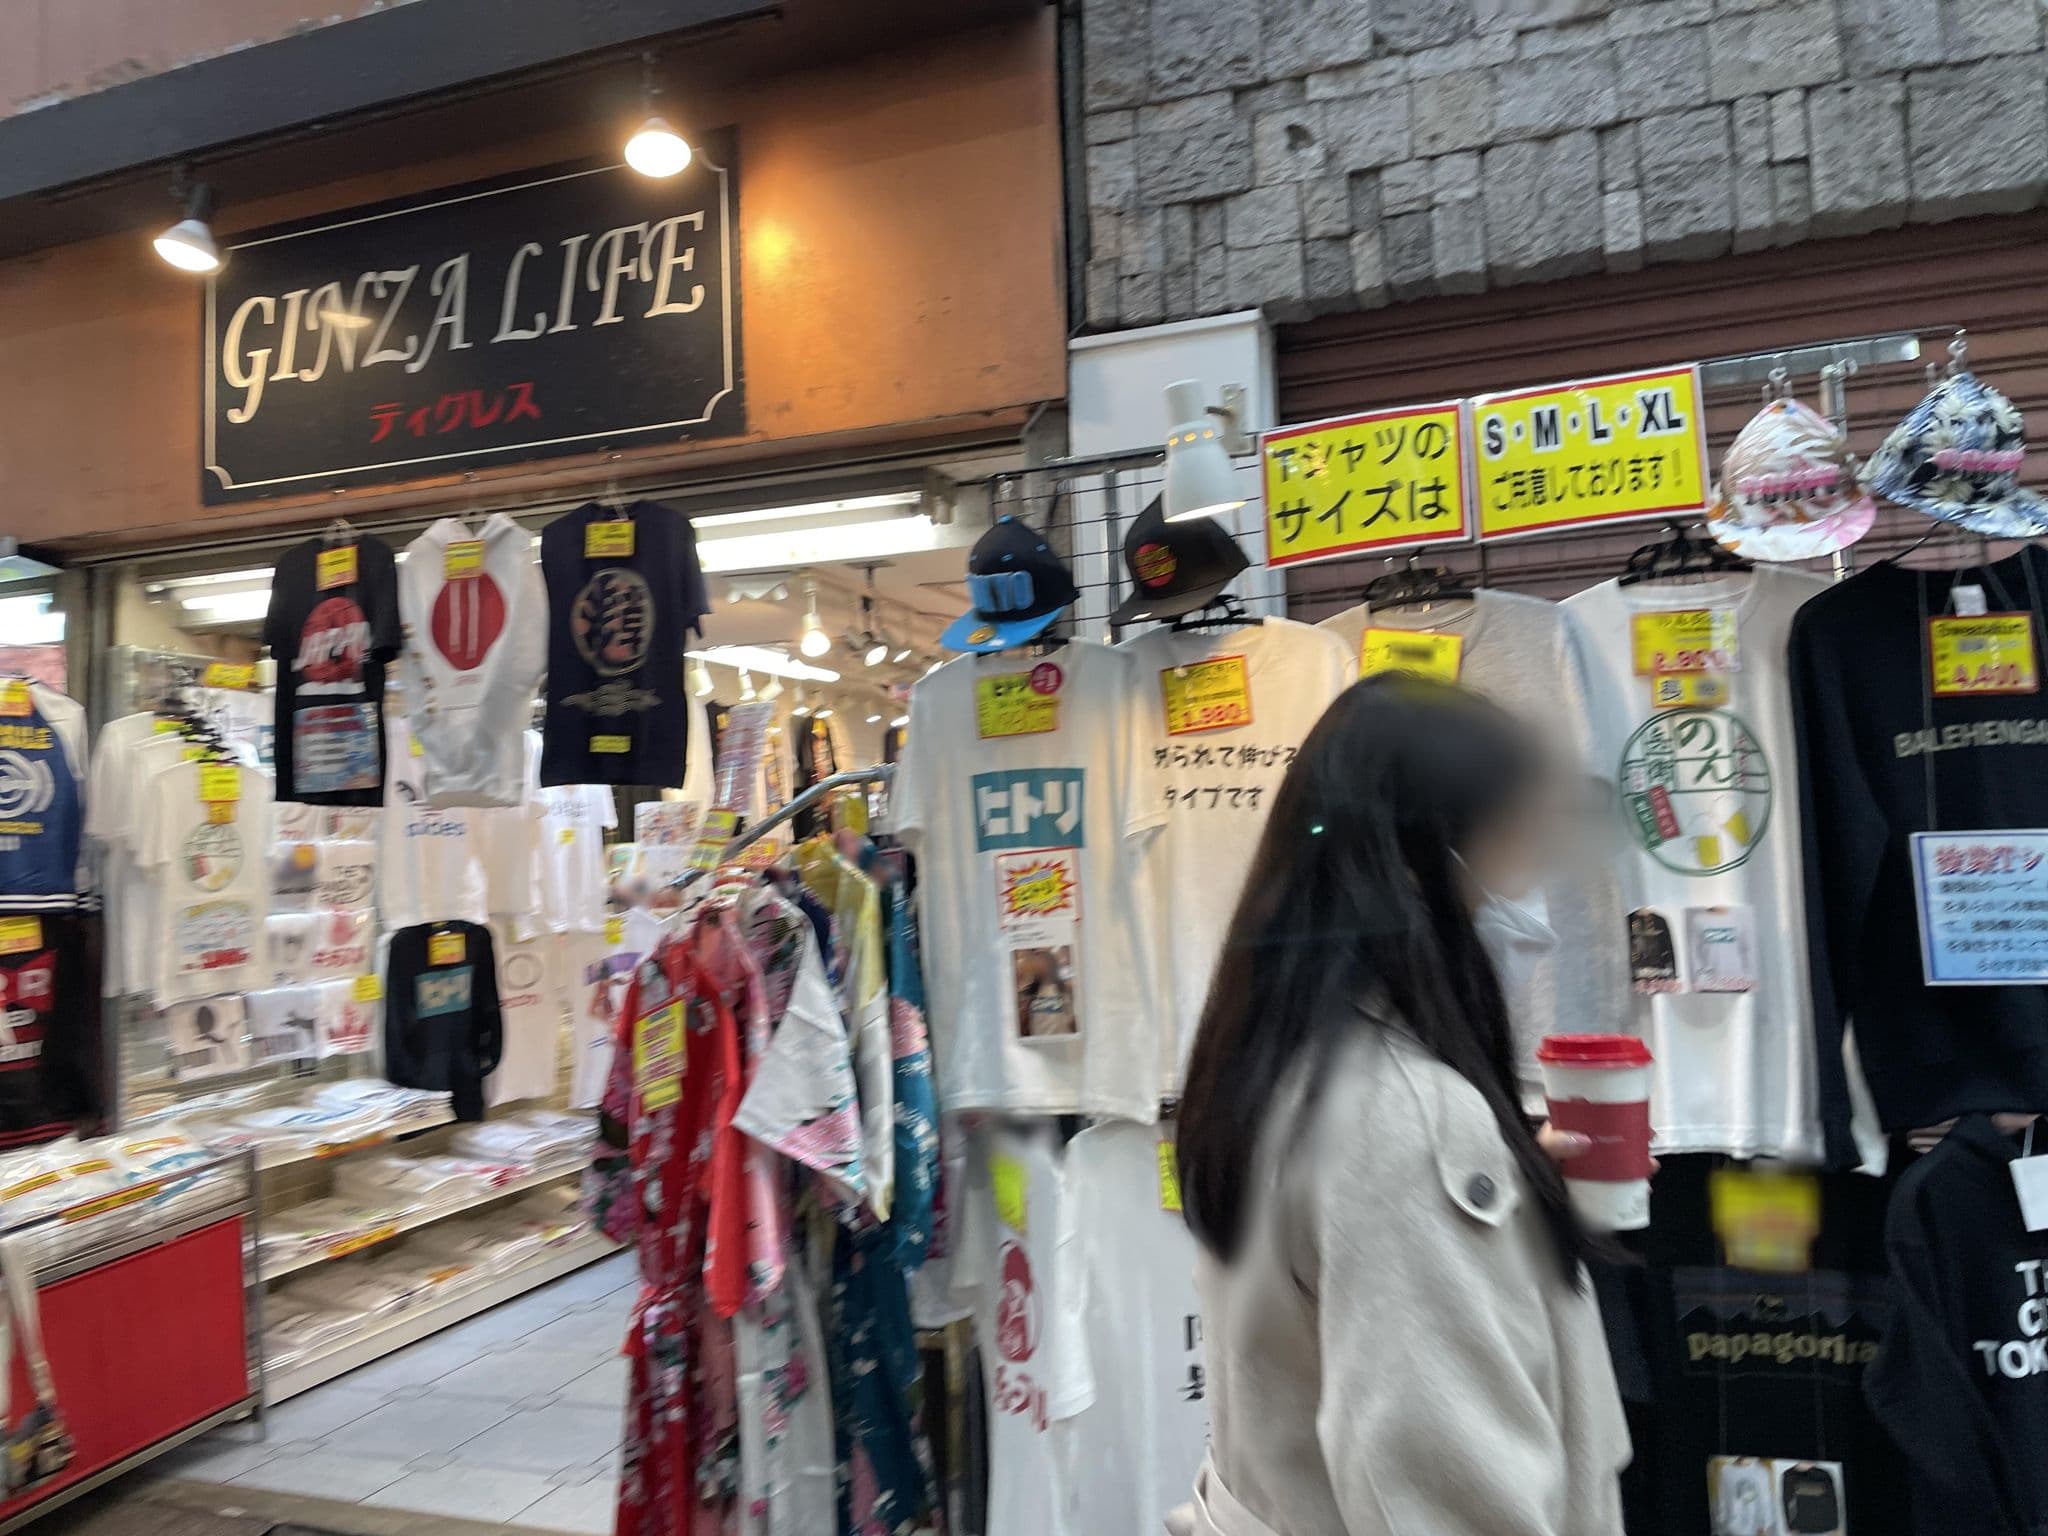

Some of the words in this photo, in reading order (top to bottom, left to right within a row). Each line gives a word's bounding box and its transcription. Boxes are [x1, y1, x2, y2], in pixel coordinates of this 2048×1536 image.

[222, 253, 474, 425] GINZA
[490, 210, 706, 345] LIFE
[1275, 477, 1450, 544] サイズは
[977, 777, 1082, 836] ヒトリ
